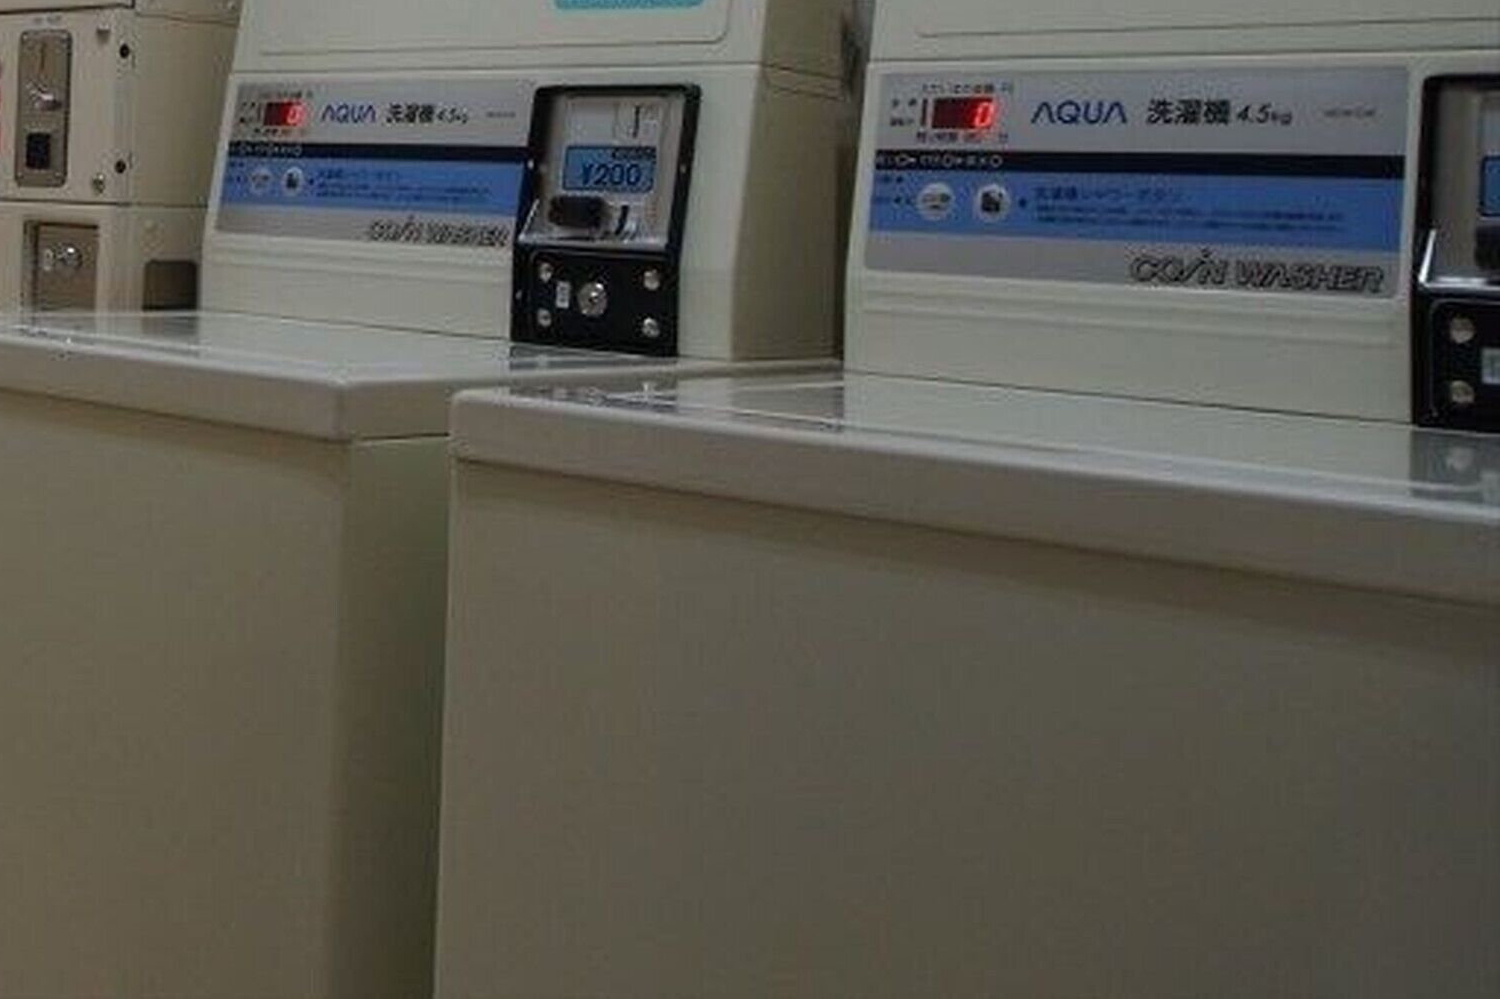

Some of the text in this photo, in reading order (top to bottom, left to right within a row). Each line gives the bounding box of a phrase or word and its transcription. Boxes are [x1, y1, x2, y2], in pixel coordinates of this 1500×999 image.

[286, 104, 305, 125] 0
[320, 103, 377, 124] AQUA
[974, 102, 996, 128] 0
[1031, 101, 1128, 125] AQUA
[1147, 99, 1231, 126] 洗濯機
[580, 162, 643, 187] ¥200
[1129, 247, 1386, 293] COIN WASHER
